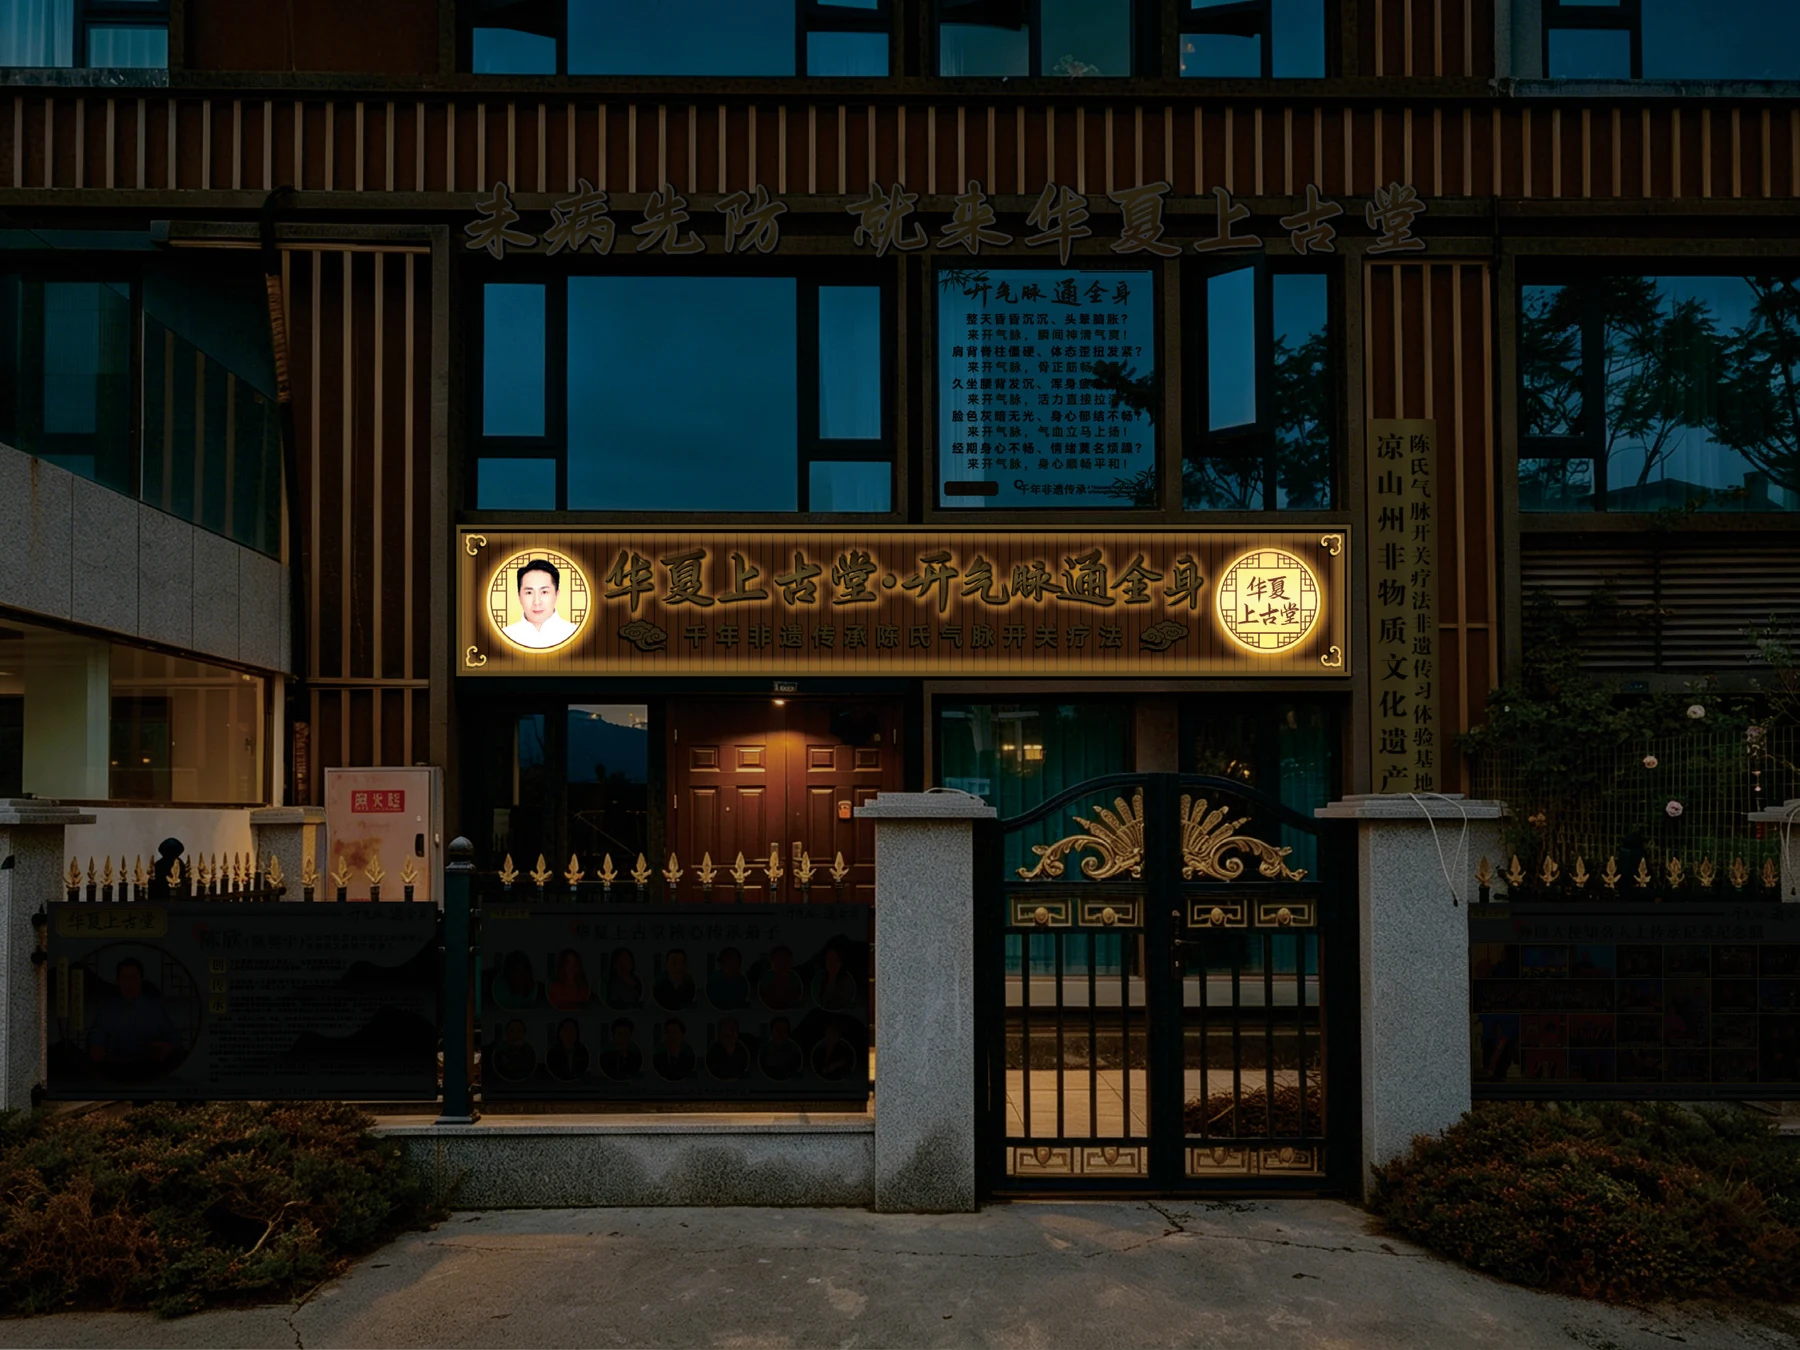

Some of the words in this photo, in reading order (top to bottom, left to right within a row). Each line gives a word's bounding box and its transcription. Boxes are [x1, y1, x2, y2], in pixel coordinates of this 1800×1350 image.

[463, 178, 789, 260] 未病先防
[845, 180, 1427, 266] 就来华夏上古堂
[604, 548, 1205, 613] 华夏上古堂·开气脉通全身
[1246, 575, 1291, 602] 华夏
[1376, 433, 1408, 792] 凉山州非物质文化遗产
[1409, 433, 1434, 792] 陈氏气脉开关疗法非遗传习体验基地
[684, 622, 1123, 650] 千年非遗传承陈氏气脉开关疗法
[1237, 602, 1301, 627] 上古堂
